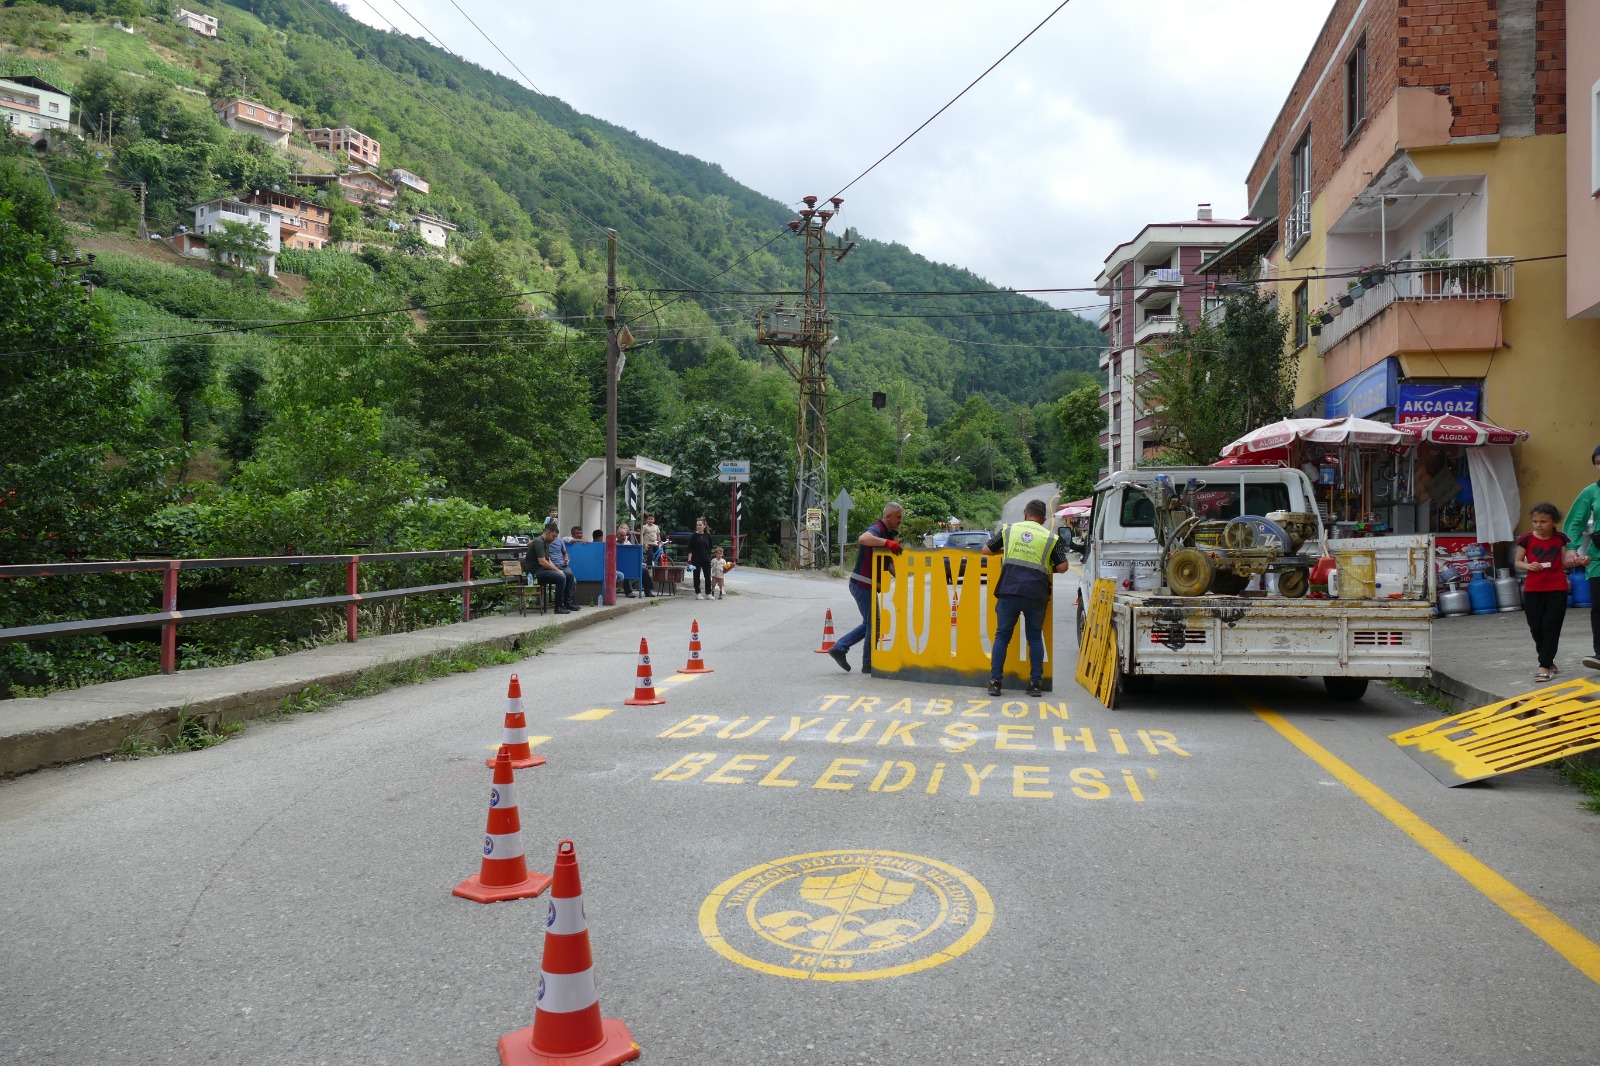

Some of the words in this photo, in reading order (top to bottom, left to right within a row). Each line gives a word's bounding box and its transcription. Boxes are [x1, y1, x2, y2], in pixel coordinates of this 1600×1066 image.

[1403, 400, 1474, 414] AKÇAGAZ
[1259, 437, 1285, 447] ALGIDA
[1438, 433, 1469, 441] ALGIDA
[818, 694, 1069, 720] TRABZON
[656, 714, 1193, 757] BÜYÜKŞEHİR
[650, 752, 1145, 802] BELEDİYESİ
[725, 865, 793, 908] TRABZON
[797, 855, 923, 871] BÜYÜKŞEHİR
[791, 953, 852, 969] 1868
